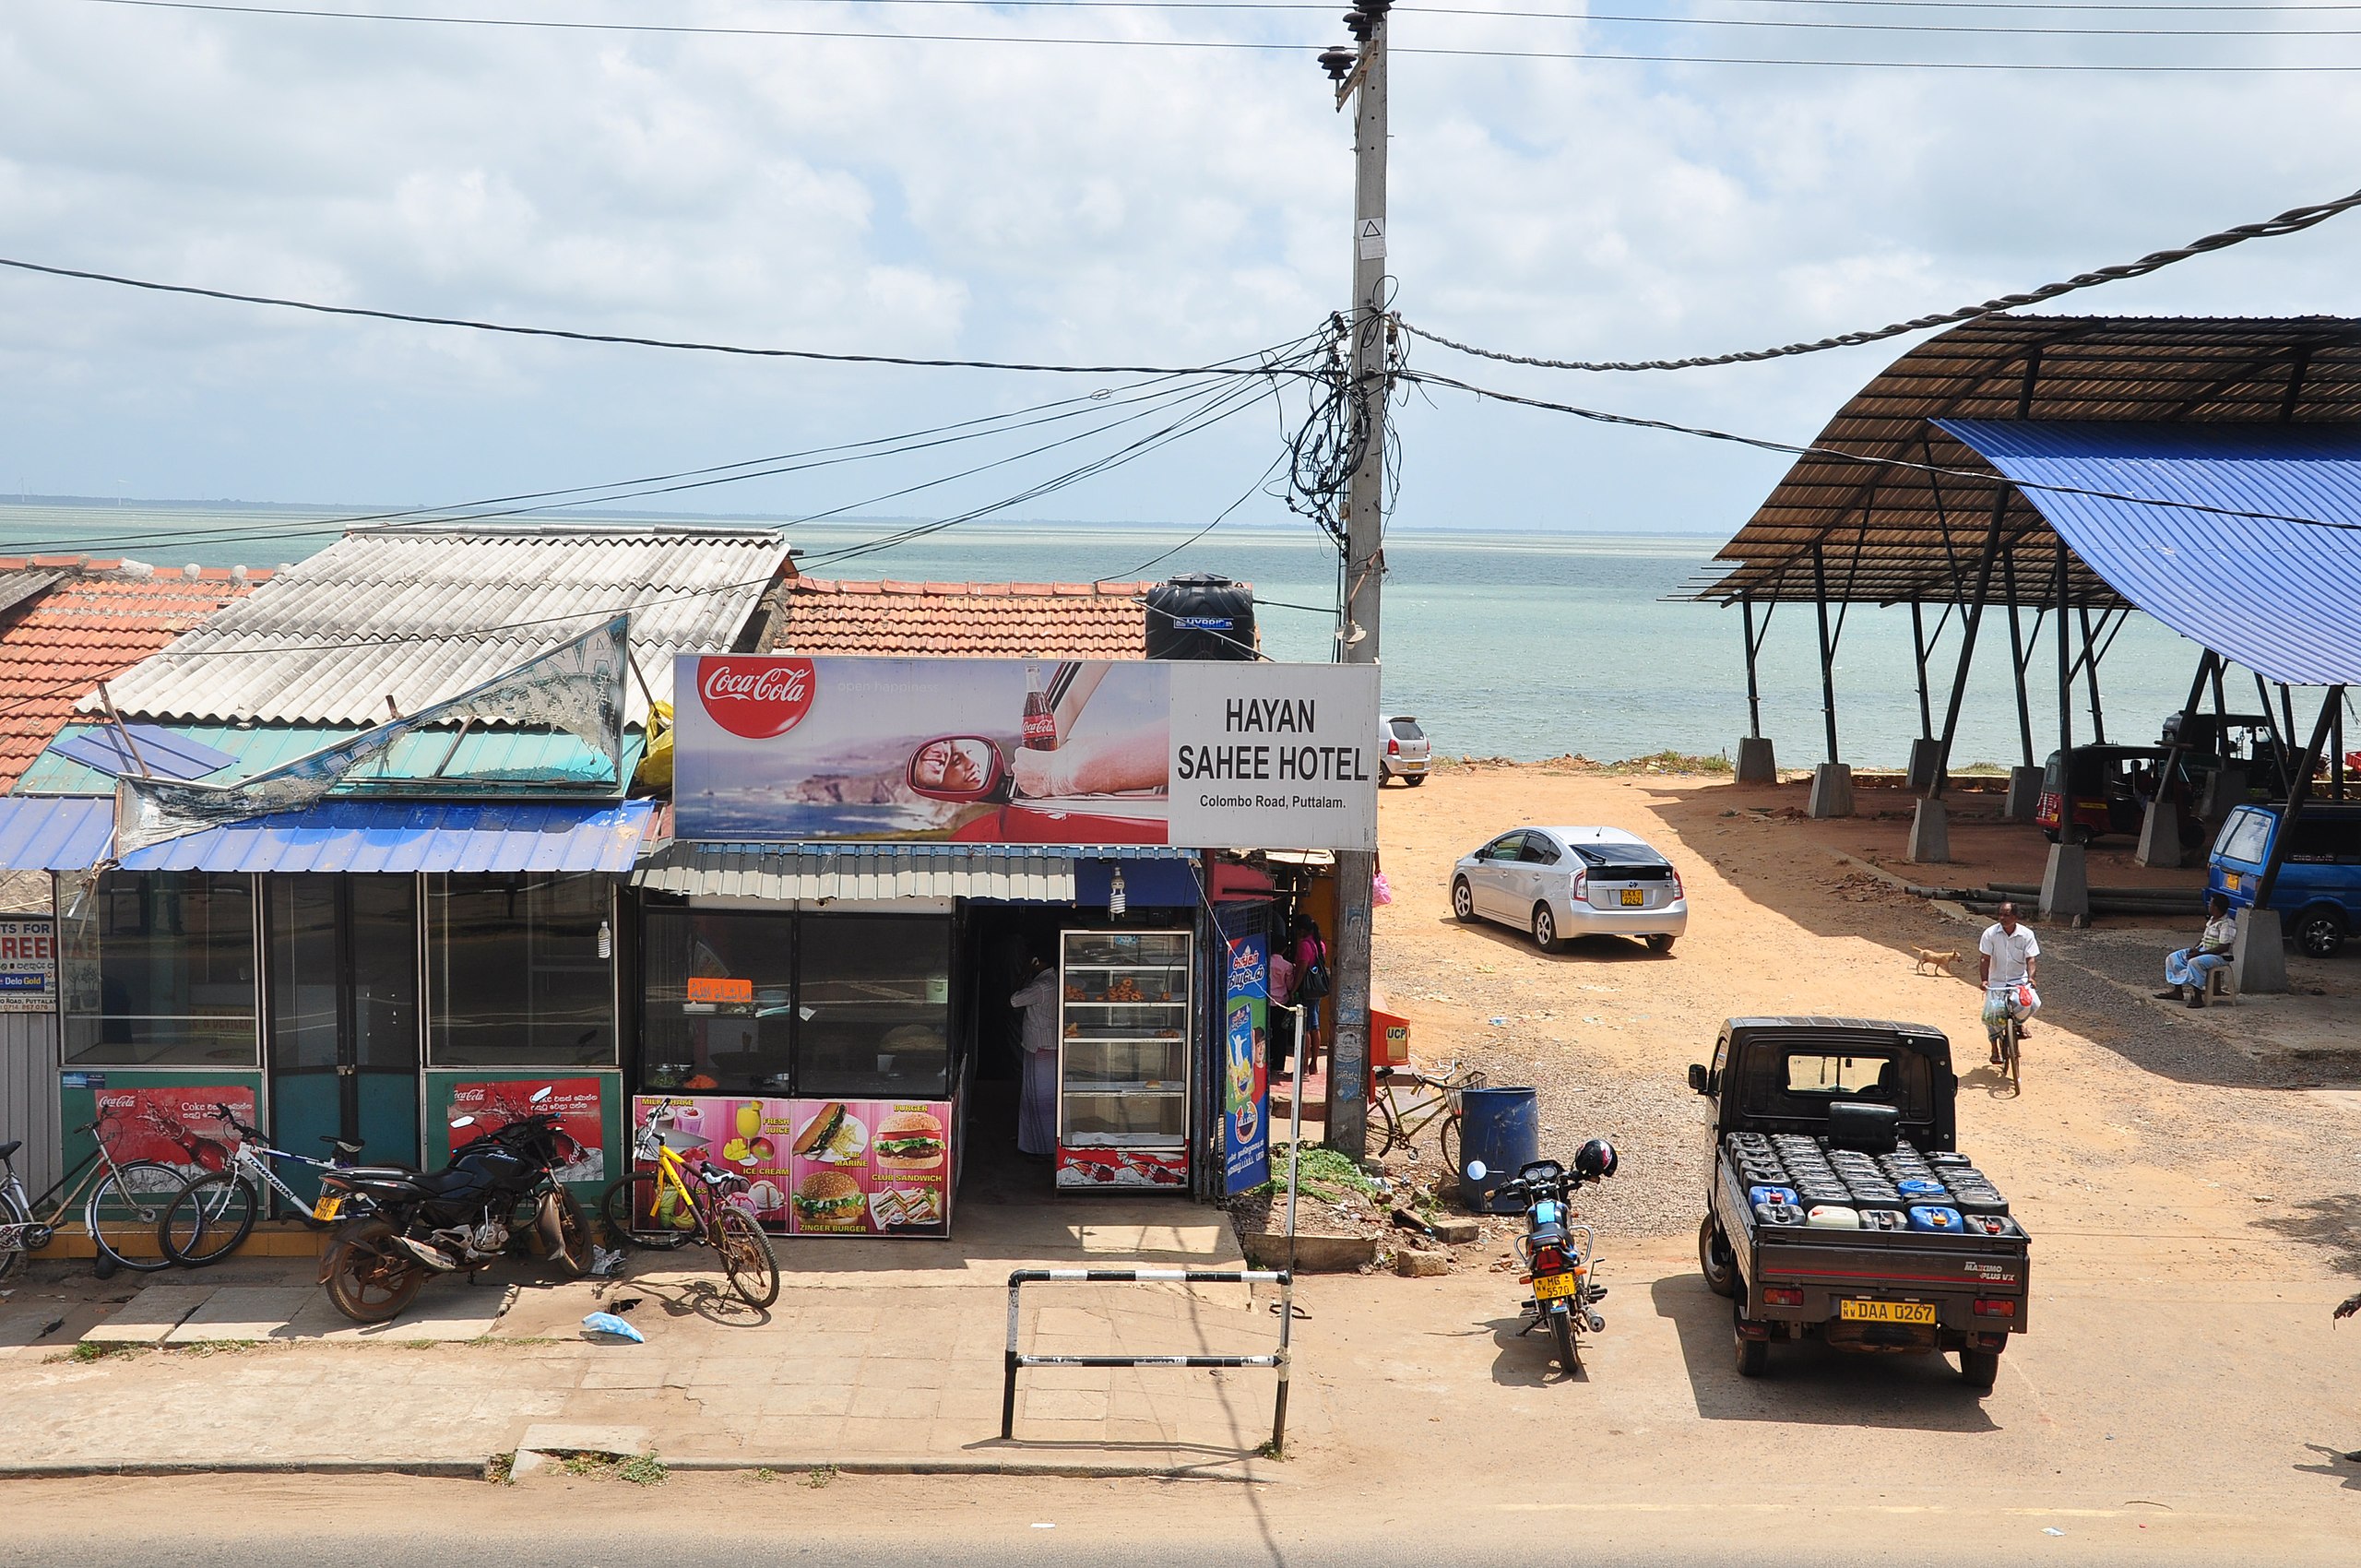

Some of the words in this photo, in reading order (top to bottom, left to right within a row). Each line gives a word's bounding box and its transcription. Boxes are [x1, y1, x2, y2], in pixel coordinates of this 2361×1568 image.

[705, 666, 812, 702] Coca-Cola
[837, 682, 870, 693] open
[876, 681, 940, 694] happiness
[1226, 698, 1315, 733] HAYAN
[1178, 744, 1270, 780] SAHEE
[1279, 746, 1370, 781] HOTEL
[1200, 794, 1252, 807] Colombo
[1255, 795, 1289, 810] Road,
[1292, 795, 1347, 809] Puttalam.
[23, 924, 50, 933] FOR
[5, 977, 22, 985] Delo
[23, 977, 42, 985] Gold
[1387, 1028, 1406, 1039] UCP
[454, 1088, 486, 1101] oca-Cola
[181, 1102, 206, 1111] Coke
[246, 1156, 293, 1200] TOMAHAWK
[800, 1224, 830, 1232] ZINGER
[832, 1225, 866, 1233] BURGER
[1547, 1285, 1570, 1297] 5570
[1858, 1303, 1888, 1319] DAA
[1894, 1305, 1933, 1321] 0267
